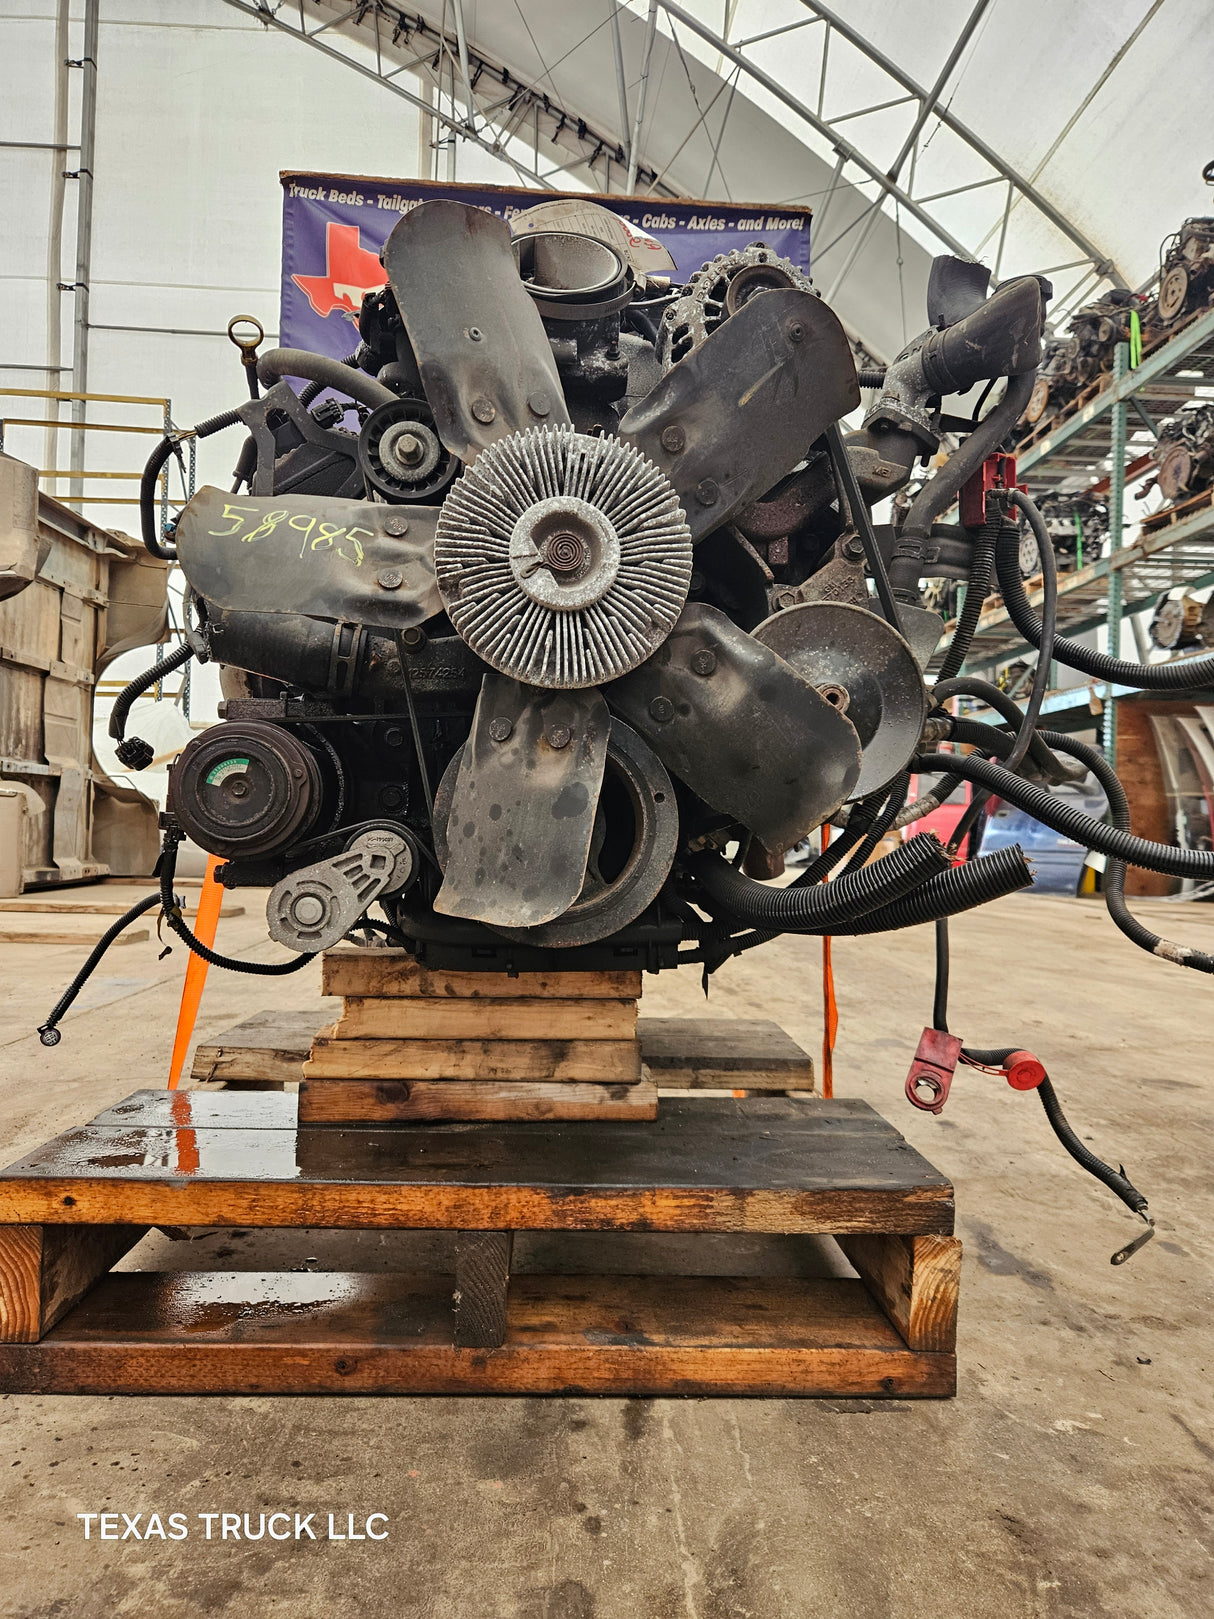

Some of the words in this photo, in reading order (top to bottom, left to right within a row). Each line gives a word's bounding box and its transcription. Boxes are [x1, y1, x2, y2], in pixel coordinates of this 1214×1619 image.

[289, 183, 327, 200] Truck
[328, 189, 364, 206] Beds
[642, 213, 676, 229] Cabs
[686, 215, 726, 230] Axles
[737, 215, 764, 231] and
[765, 217, 805, 231] More!
[208, 504, 374, 567] 58985
